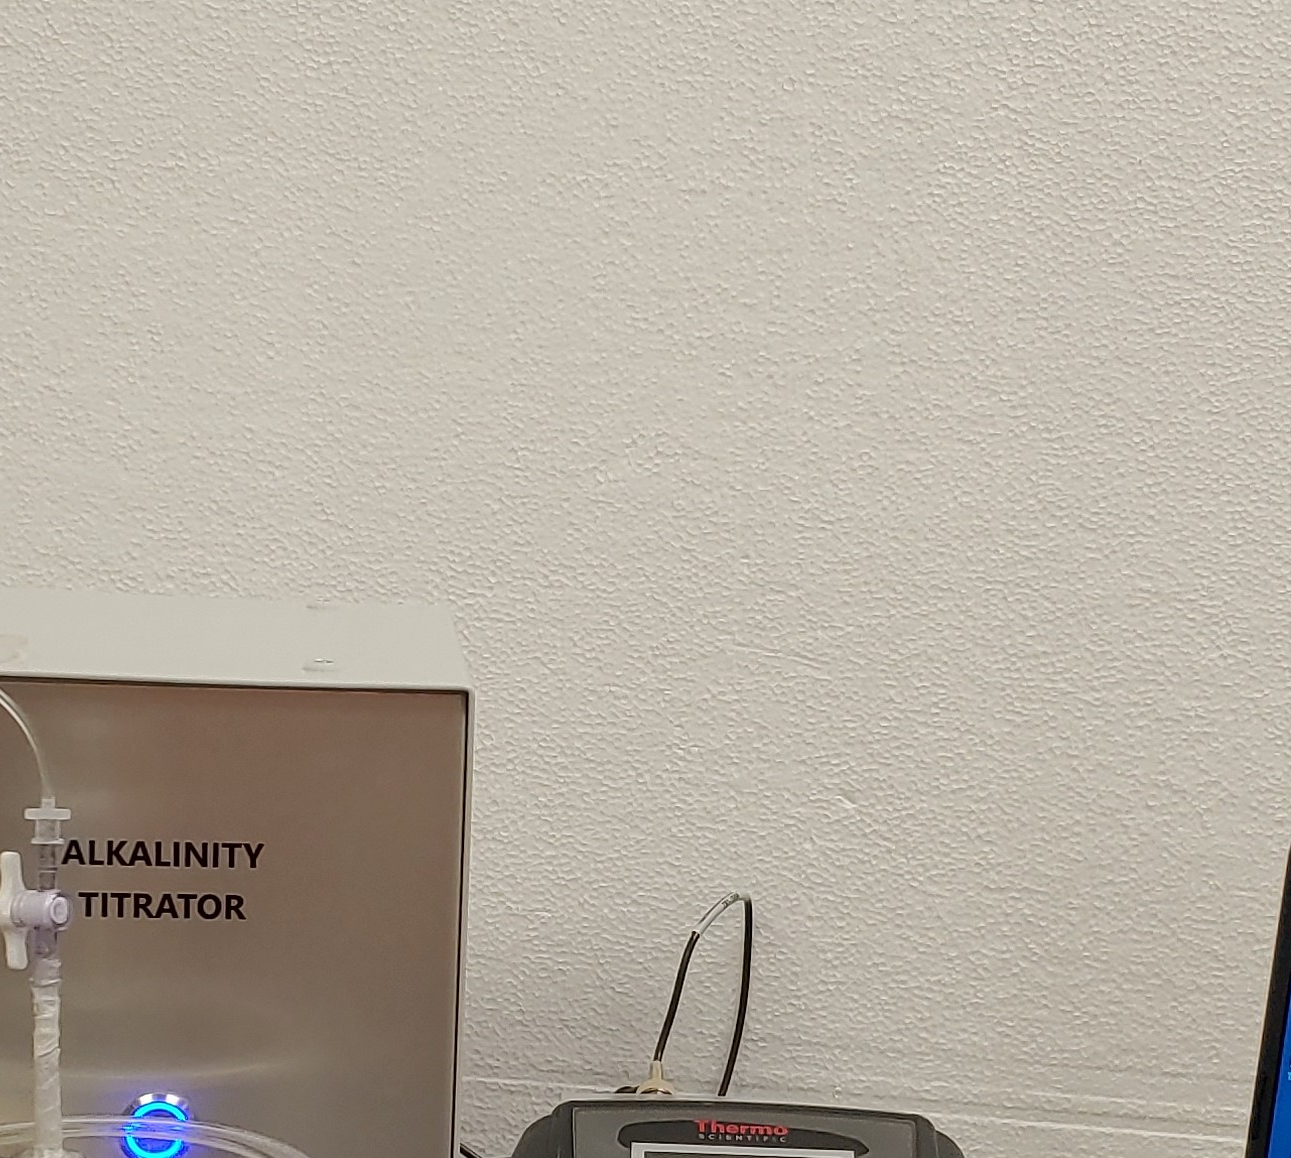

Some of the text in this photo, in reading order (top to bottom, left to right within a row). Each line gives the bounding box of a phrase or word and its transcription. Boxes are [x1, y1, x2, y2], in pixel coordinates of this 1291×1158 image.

[61, 839, 265, 869] ALKALINITY
[78, 891, 246, 921] TITRATOR
[693, 1120, 789, 1136] Thermo
[698, 1134, 787, 1143] SCIENTIFIC
